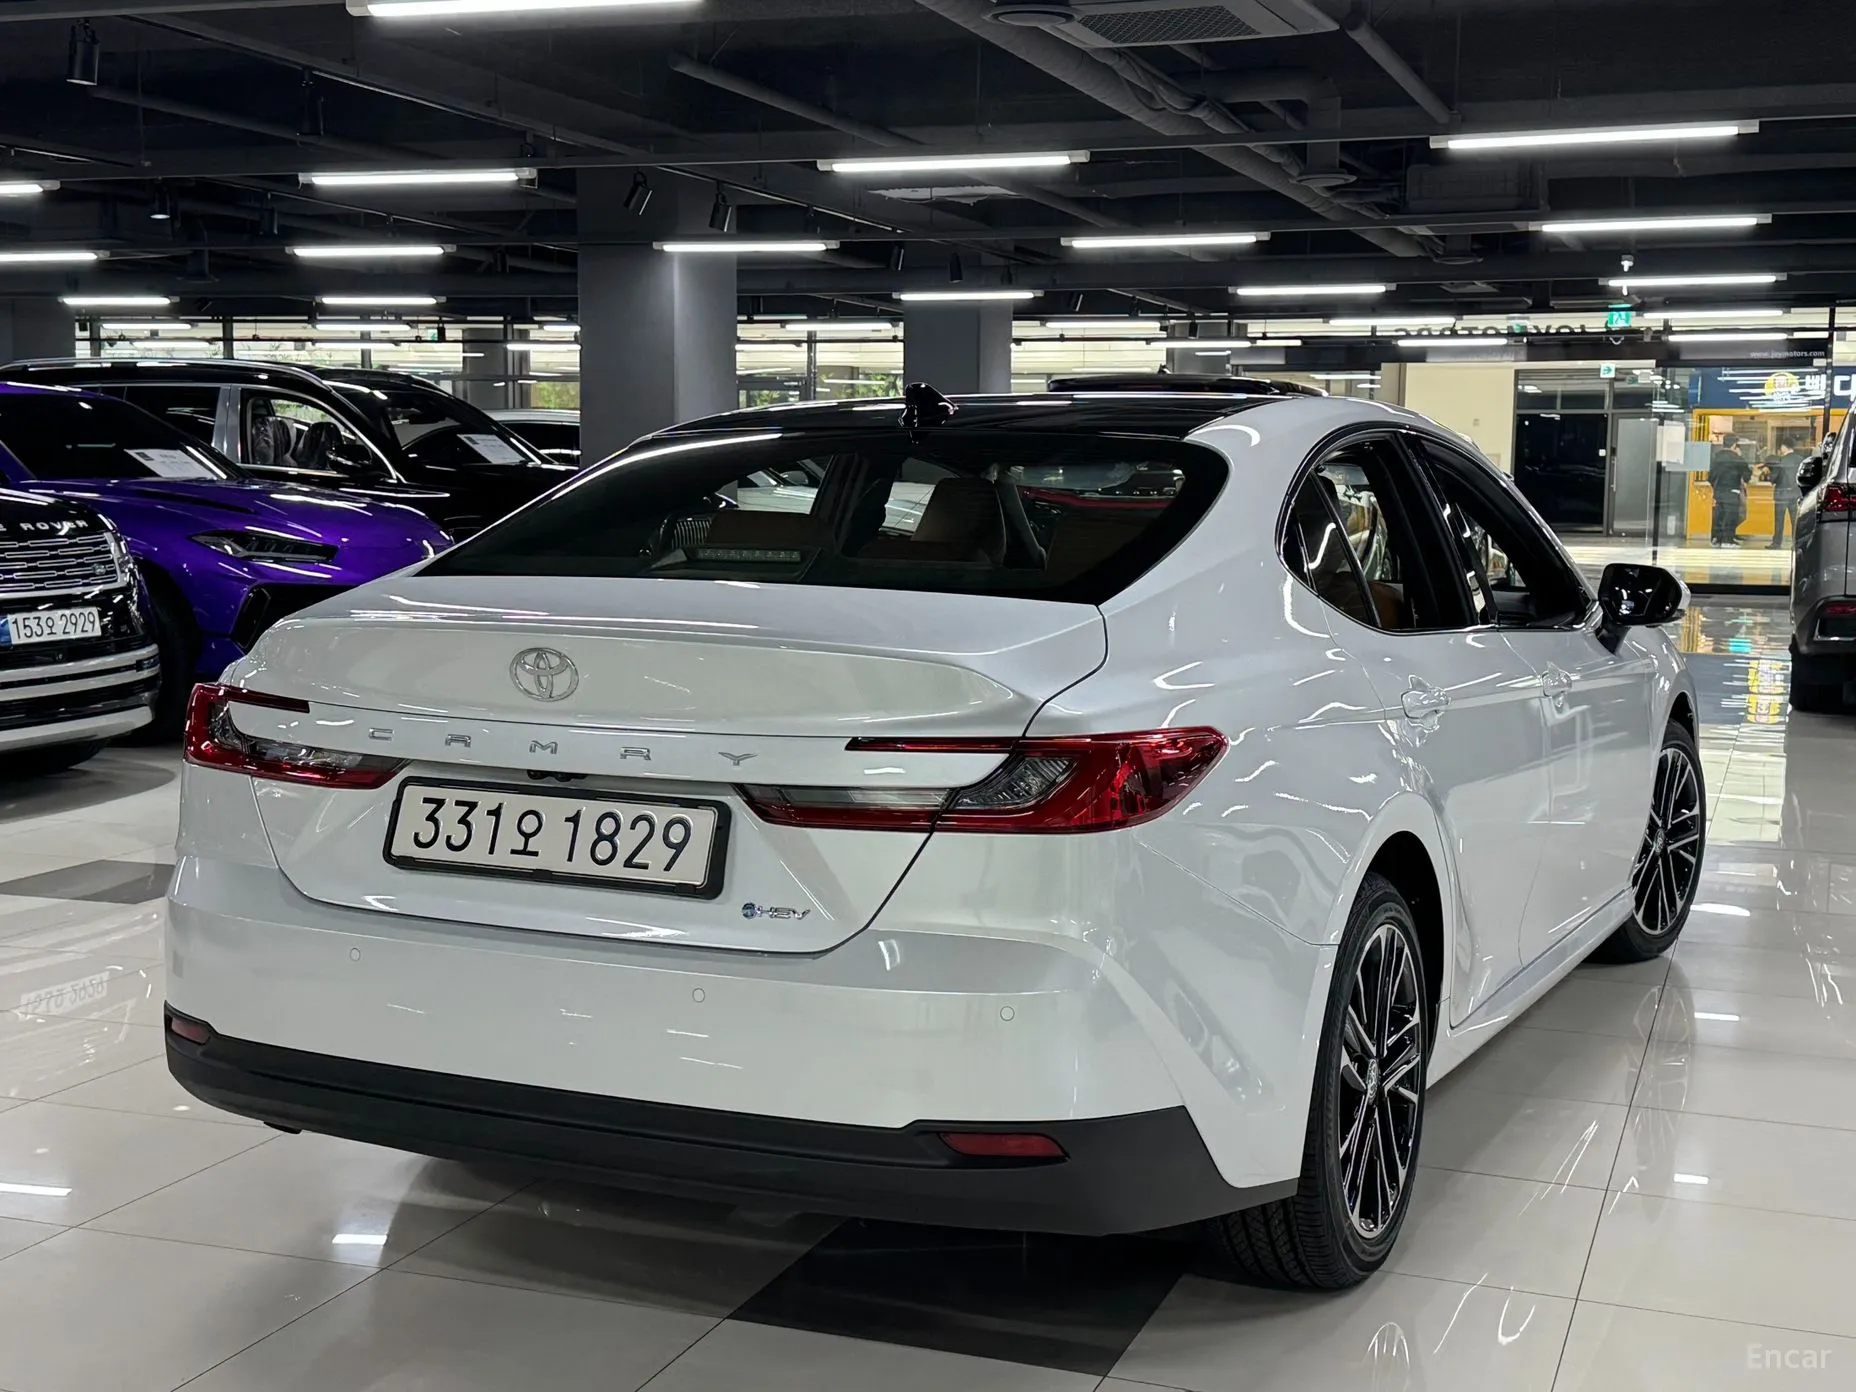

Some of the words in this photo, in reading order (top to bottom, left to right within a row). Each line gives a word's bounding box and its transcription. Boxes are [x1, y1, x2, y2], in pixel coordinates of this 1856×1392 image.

[11, 616, 57, 640] 153오
[59, 611, 96, 635] 2929
[368, 727, 758, 767] CAMRY
[412, 796, 544, 858] 331오
[563, 807, 692, 872] 1829
